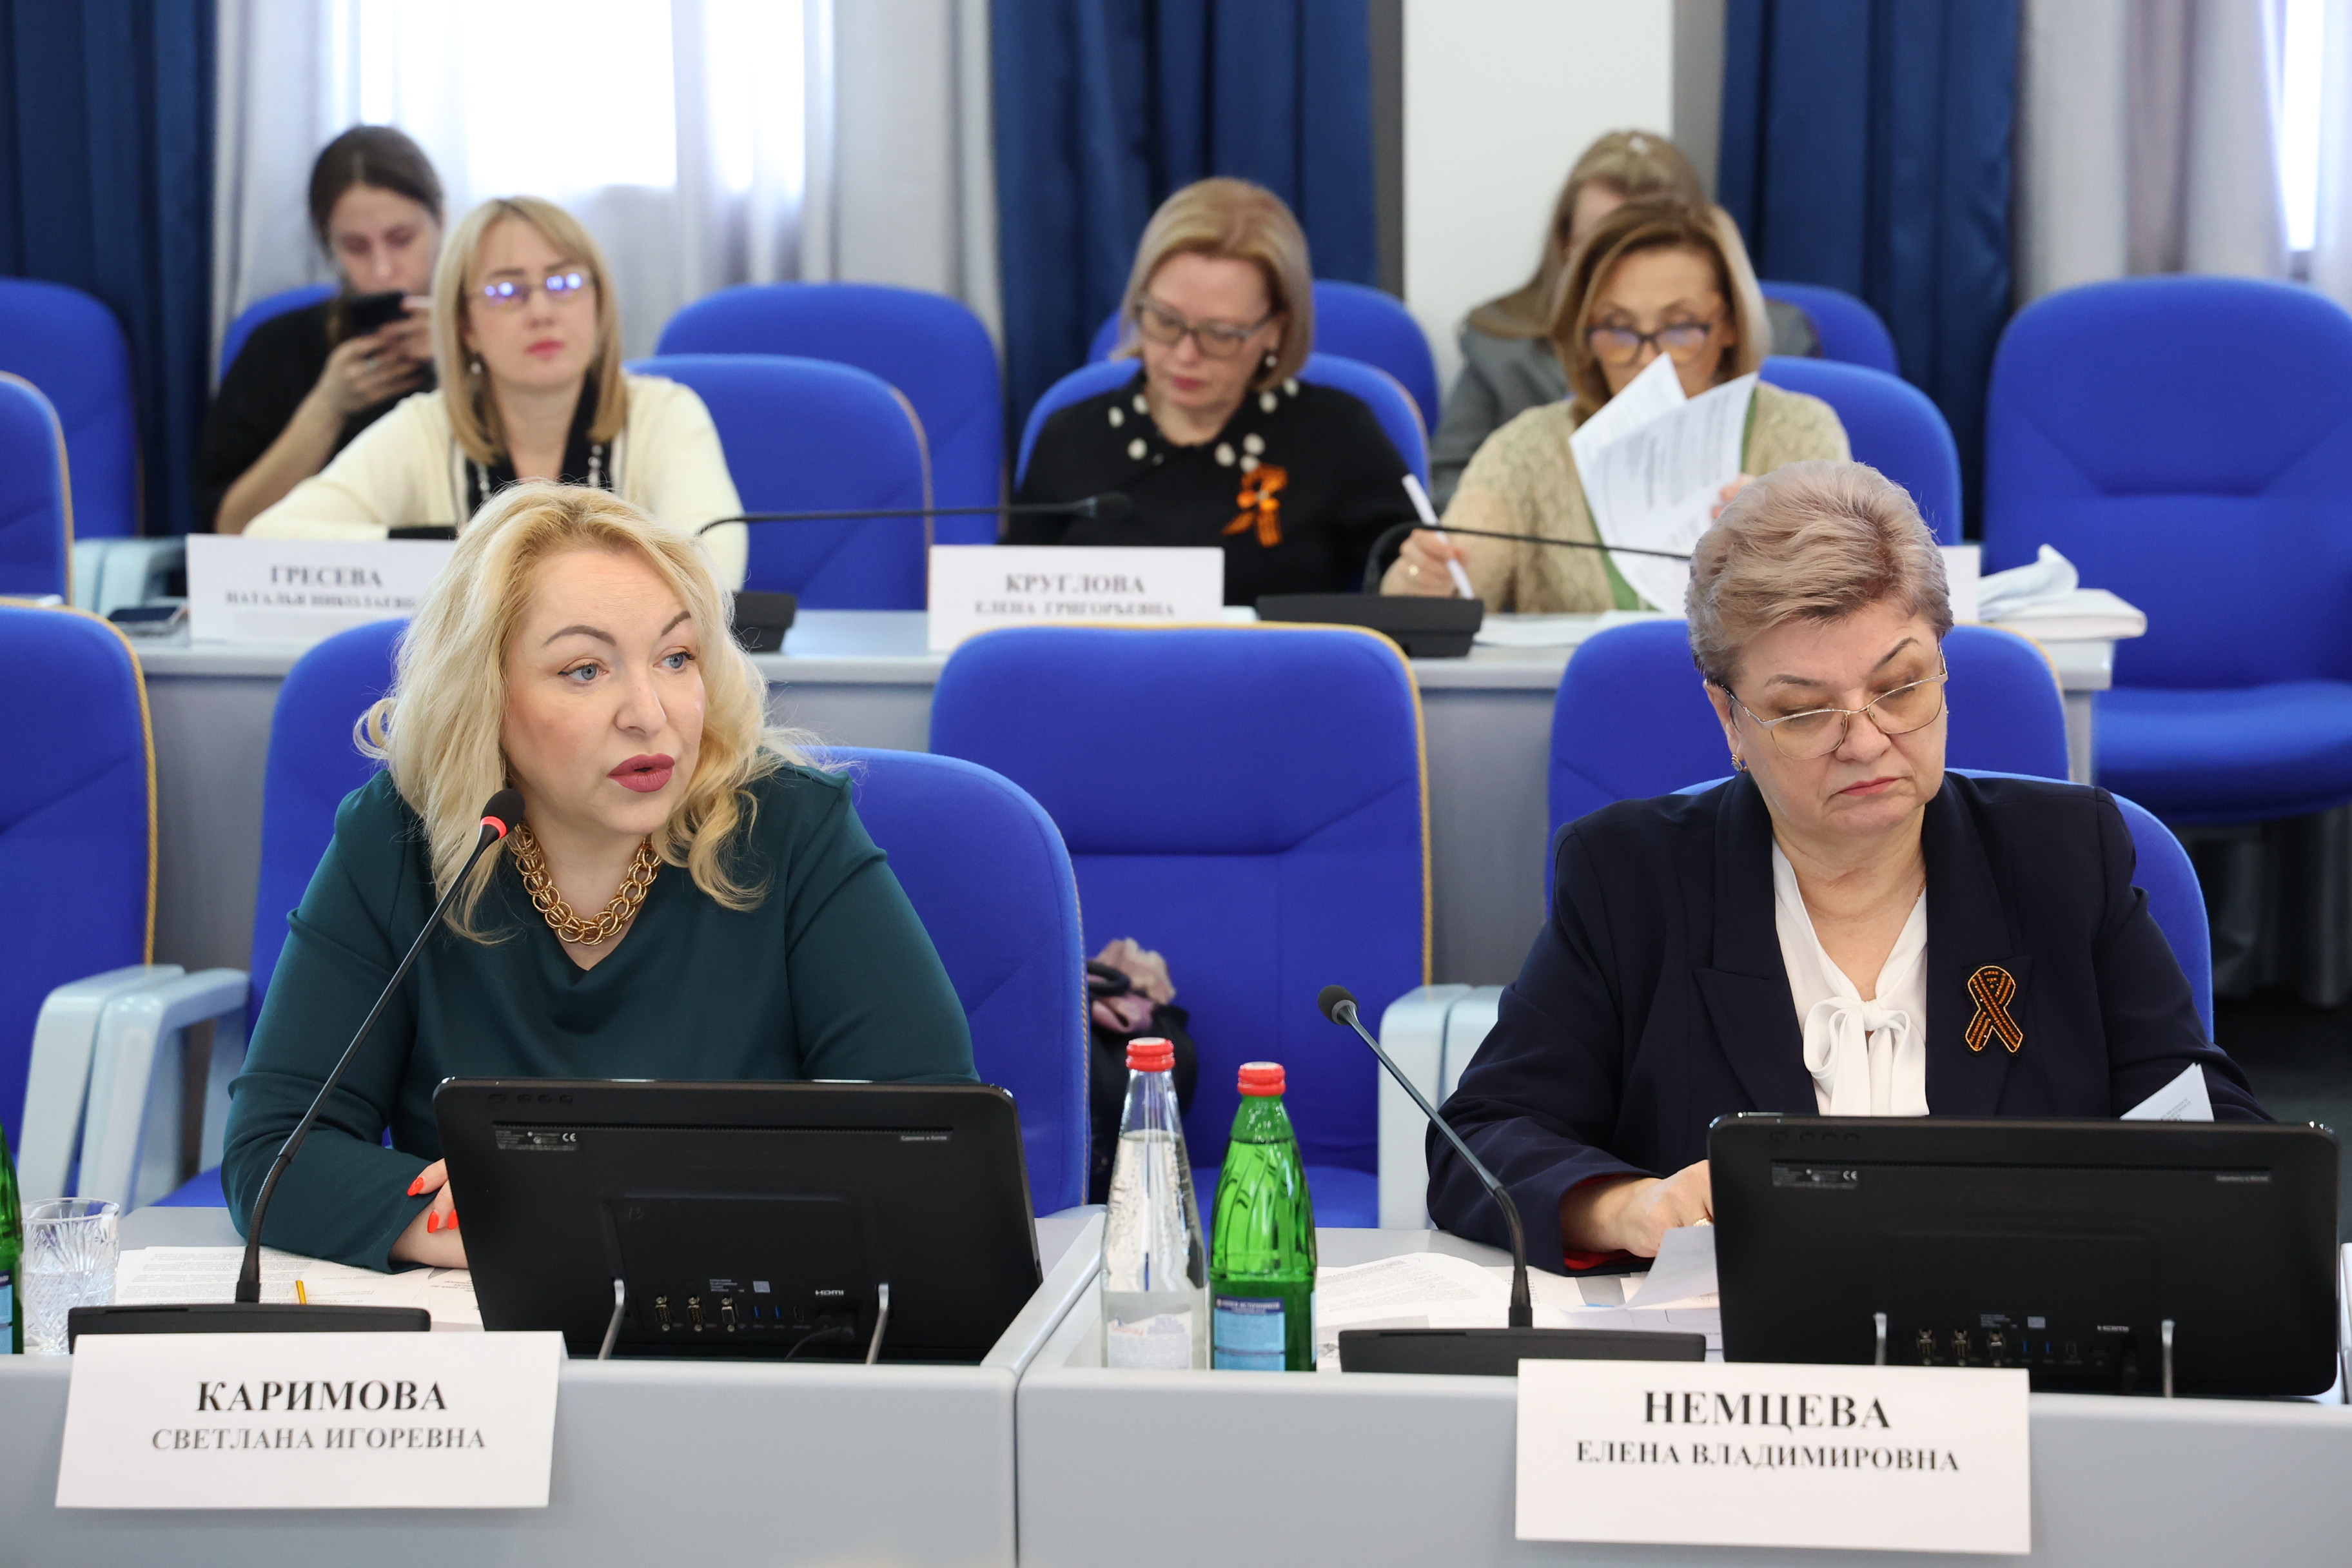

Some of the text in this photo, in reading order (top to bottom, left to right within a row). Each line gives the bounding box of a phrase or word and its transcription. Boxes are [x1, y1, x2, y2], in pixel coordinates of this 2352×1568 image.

[271, 565, 382, 587] ГРЕСЕВА
[1005, 573, 1145, 594] КРУГЛОВА
[226, 591, 306, 606] НАТАЛЬЯ
[974, 600, 1175, 616] ЕЛЕНА ГРИГОРЬЕВНА
[196, 1380, 447, 1412] КАРИМОВА
[1645, 1391, 1891, 1433] НЕМЦЕВА
[152, 1427, 485, 1450] СВЕТЛАНА ИГОРЕВНА
[1577, 1440, 1960, 1472] ЕЛЕНА ВЛАДИМИРОВНА
